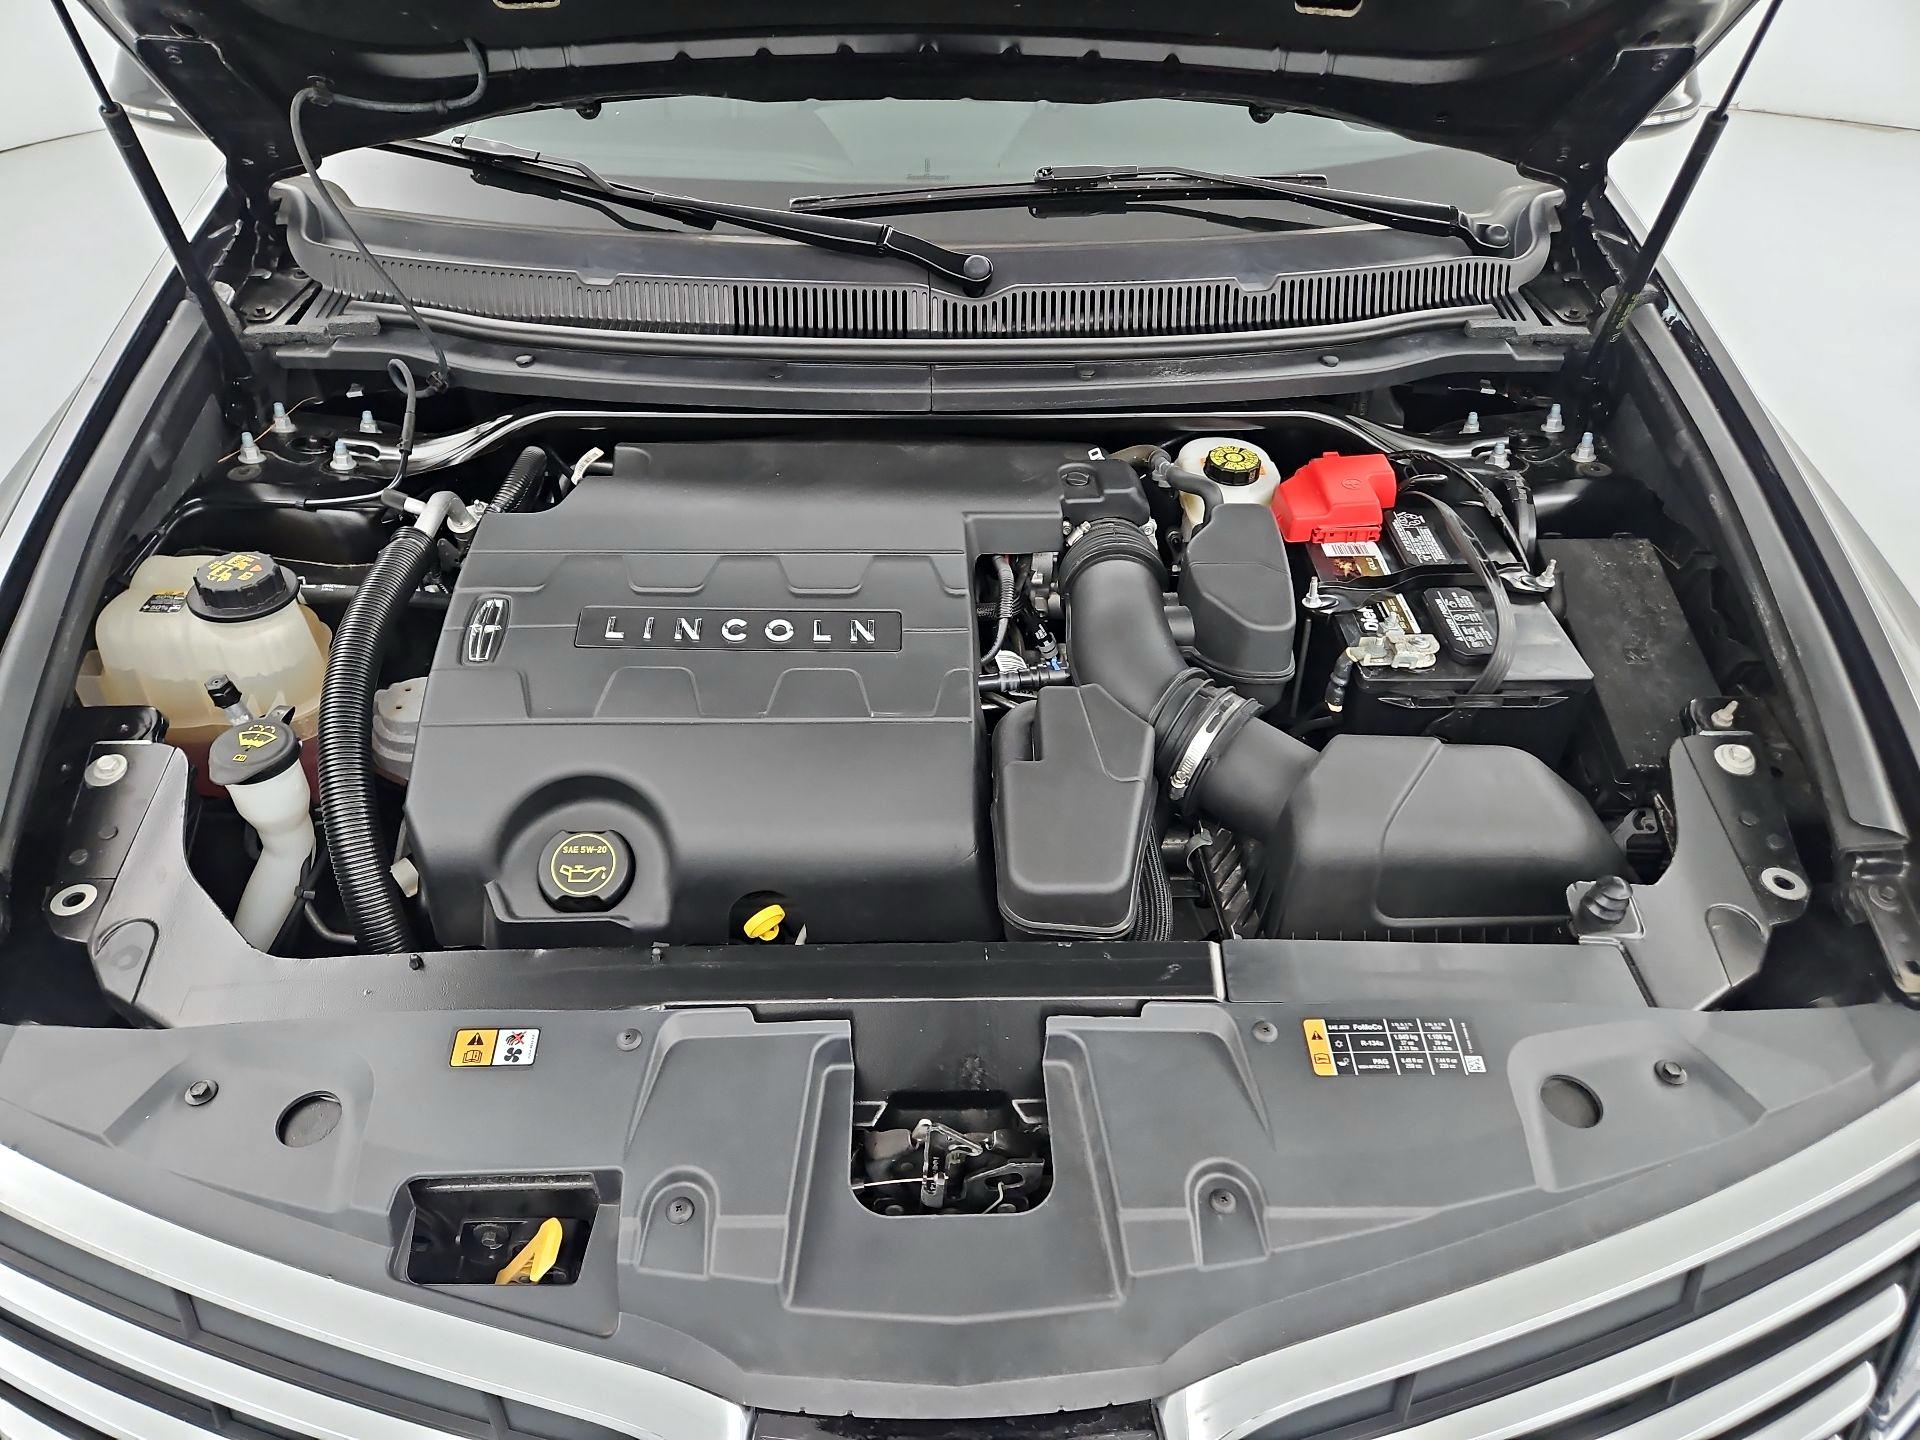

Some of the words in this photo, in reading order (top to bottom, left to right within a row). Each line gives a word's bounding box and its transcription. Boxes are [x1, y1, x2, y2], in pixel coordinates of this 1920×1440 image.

[604, 616, 875, 642] LINCOLN
[562, 846, 578, 854] SAE
[580, 846, 607, 854] 5W-20
